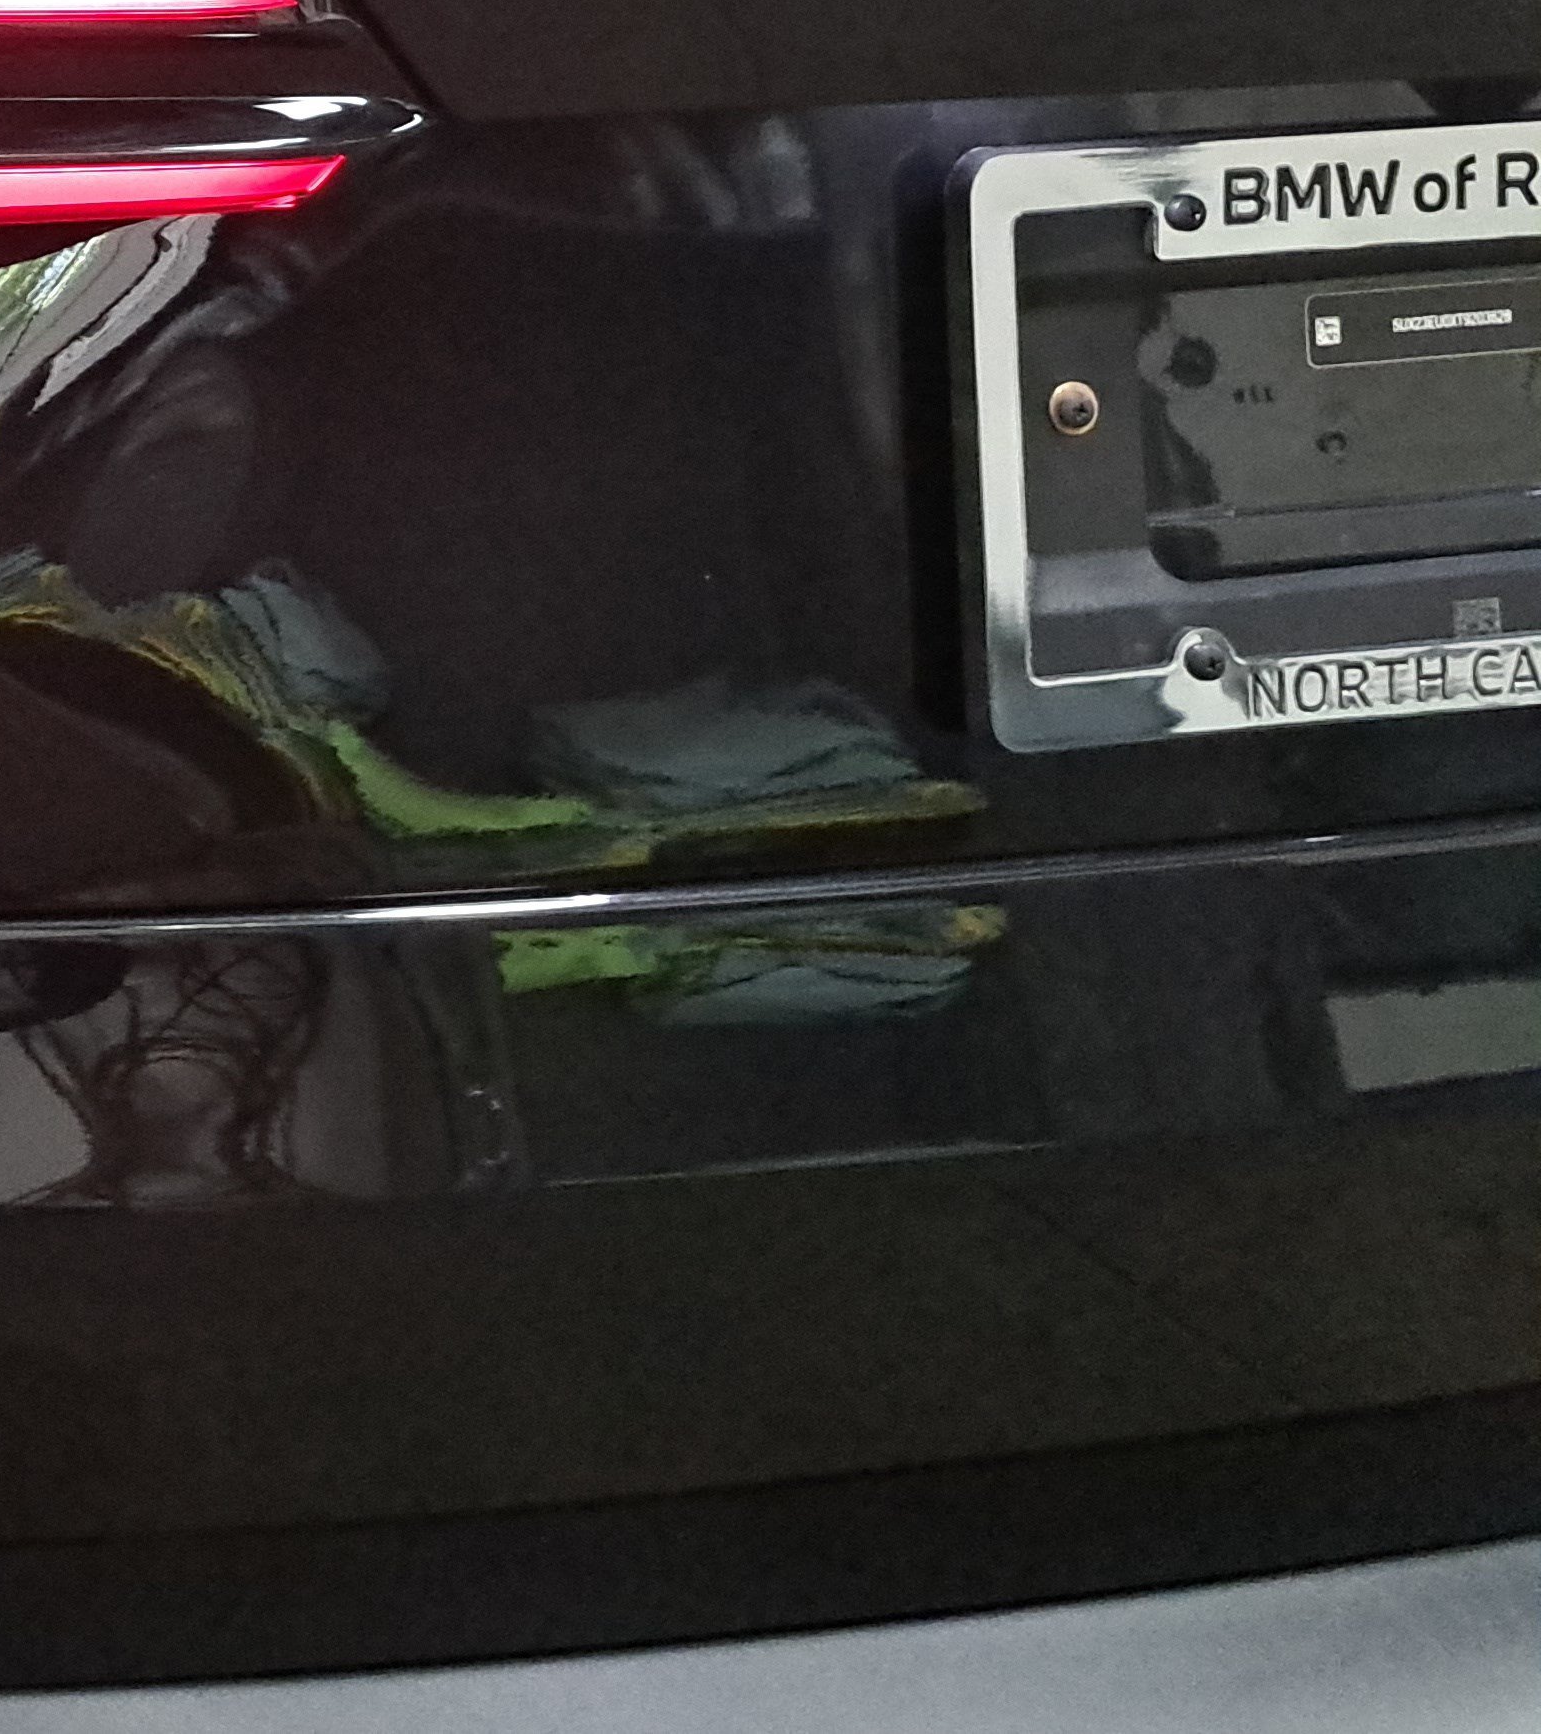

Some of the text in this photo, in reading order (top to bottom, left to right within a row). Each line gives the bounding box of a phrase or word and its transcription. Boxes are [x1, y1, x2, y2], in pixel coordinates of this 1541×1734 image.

[1223, 160, 1401, 226] BMW
[1413, 153, 1477, 213] of
[1249, 654, 1450, 718] NORTH
